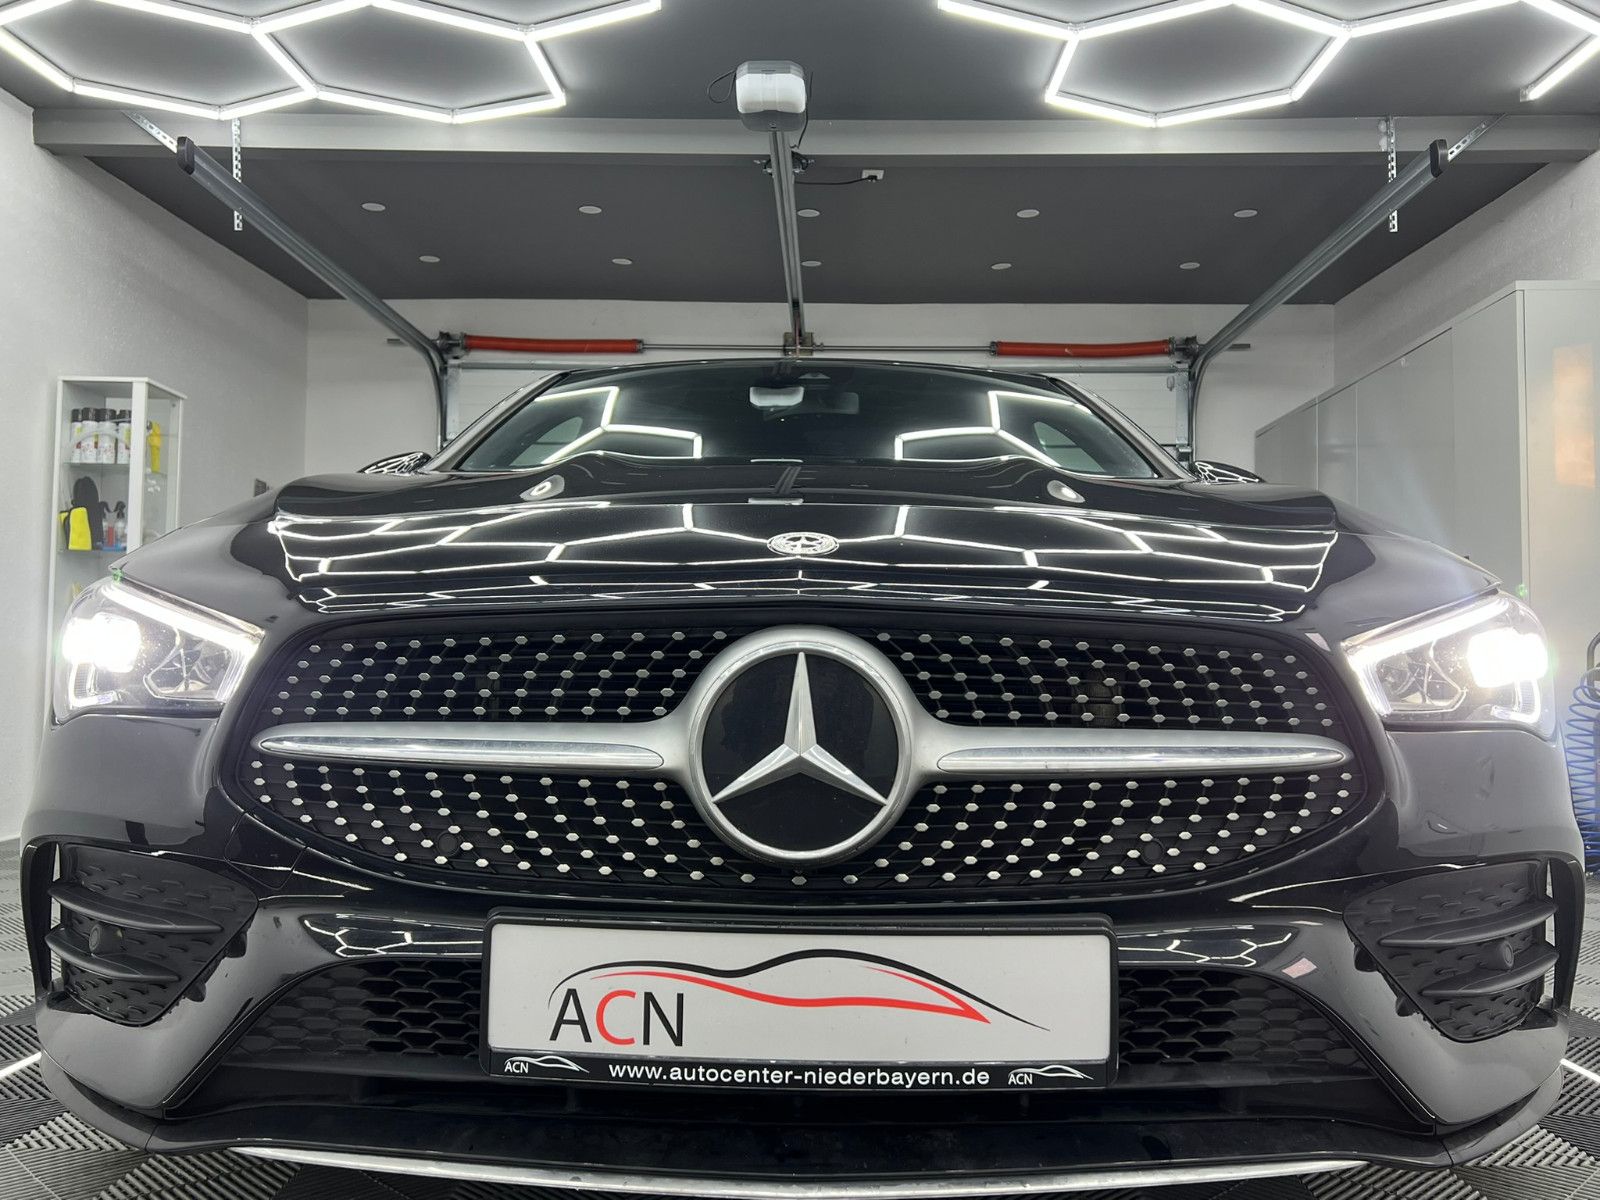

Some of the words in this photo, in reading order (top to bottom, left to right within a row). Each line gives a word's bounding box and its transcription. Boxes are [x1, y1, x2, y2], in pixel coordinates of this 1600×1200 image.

[549, 988, 684, 1047] ACN
[504, 1061, 529, 1074] ACN
[608, 1063, 990, 1088] www.autocenter-niederbayern.de
[1008, 1073, 1033, 1085] ACN
